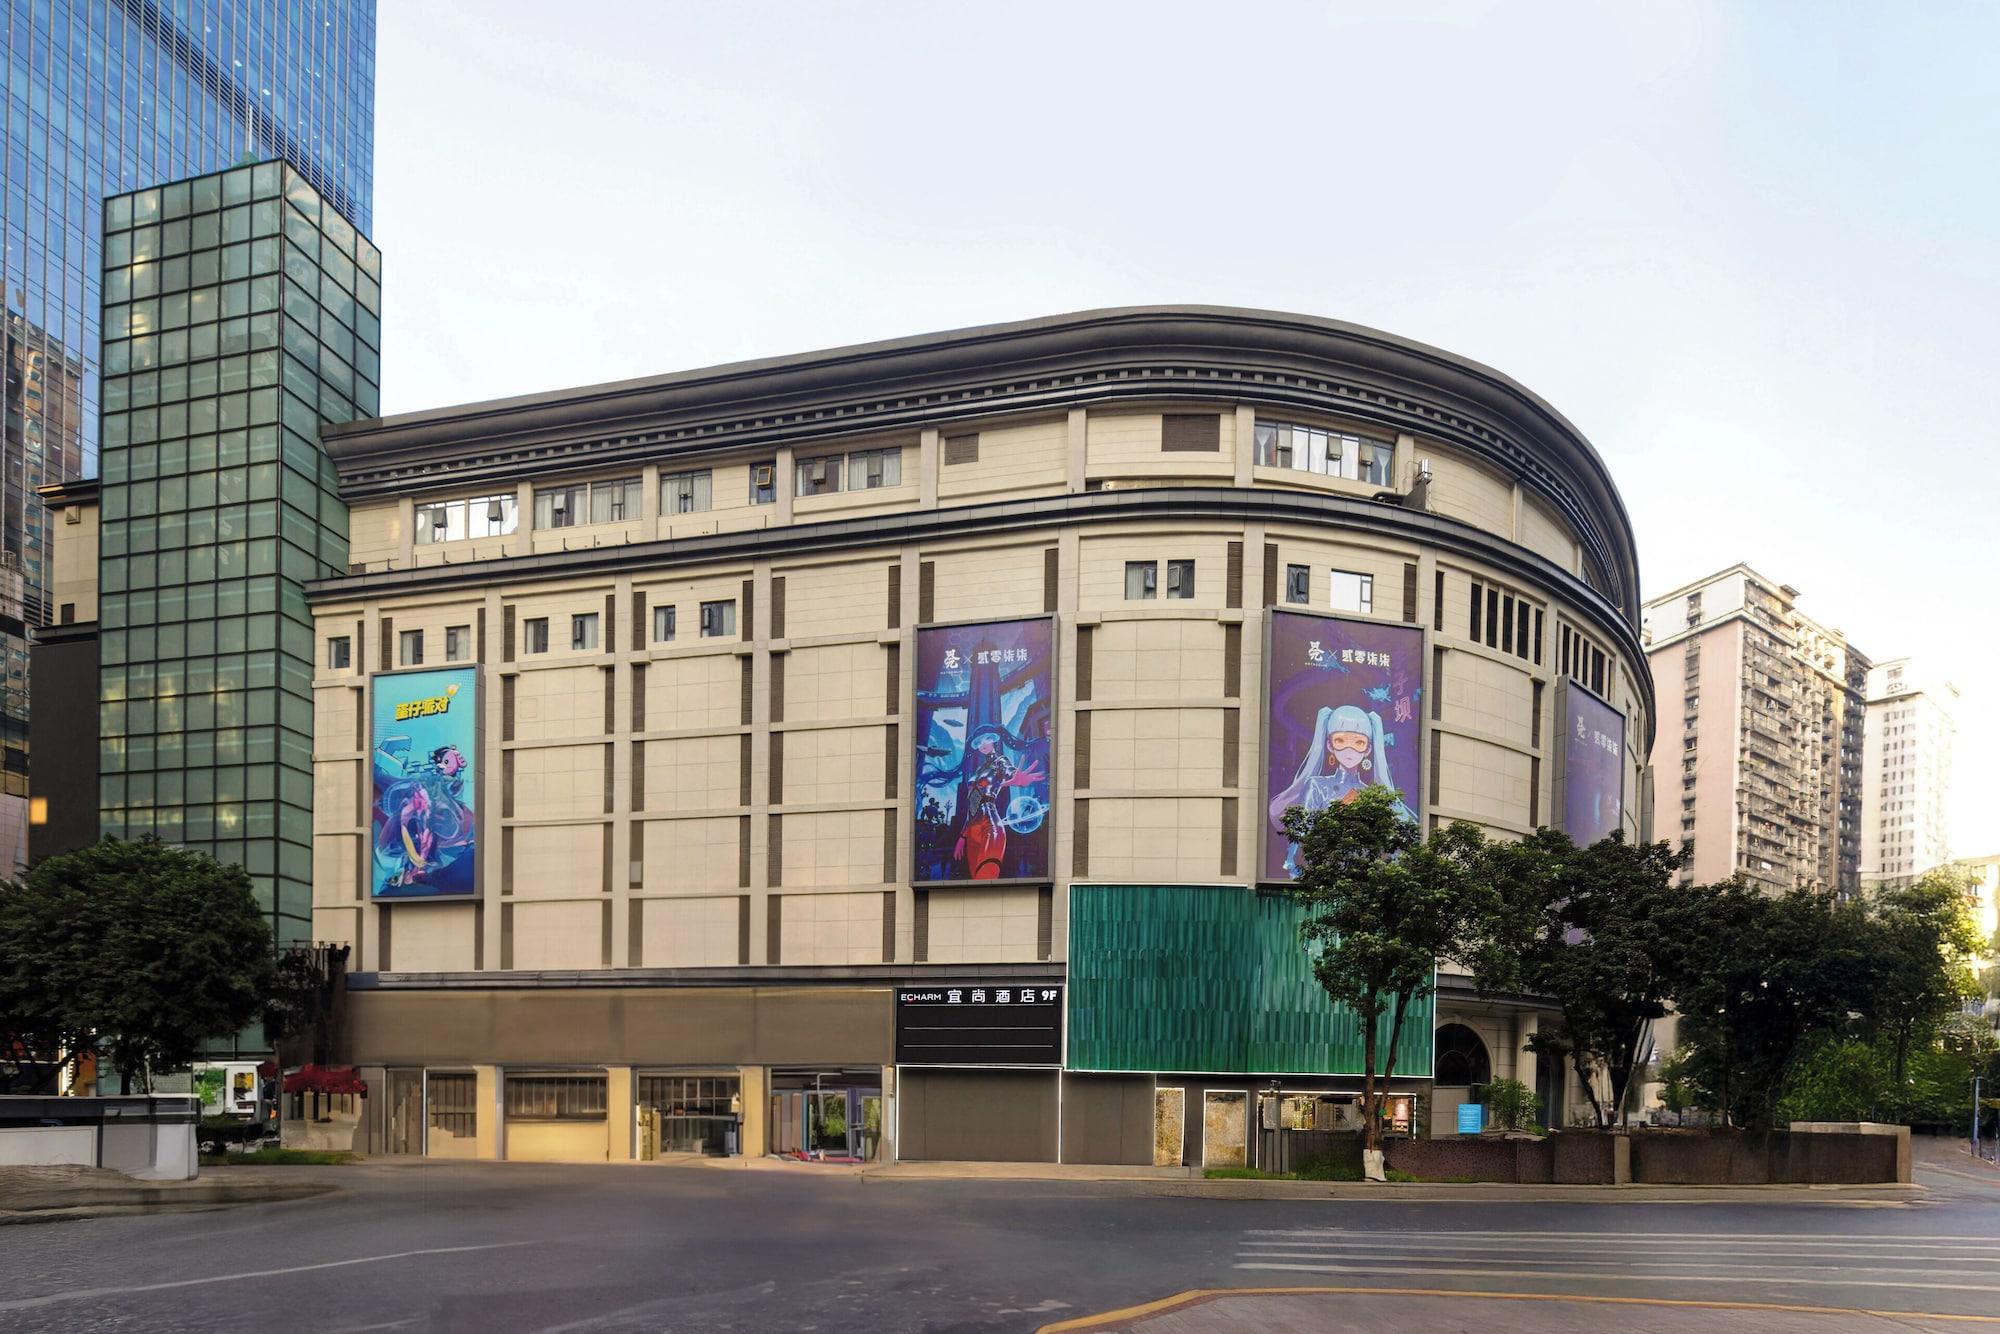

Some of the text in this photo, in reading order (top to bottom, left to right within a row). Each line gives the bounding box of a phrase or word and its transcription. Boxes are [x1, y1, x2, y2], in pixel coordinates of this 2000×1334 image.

[1341, 648, 1391, 667] 贰零柒柒
[395, 696, 451, 721] 蛋仔派对
[900, 989, 1058, 1003] ECHARM 宜尚酒店 9F
